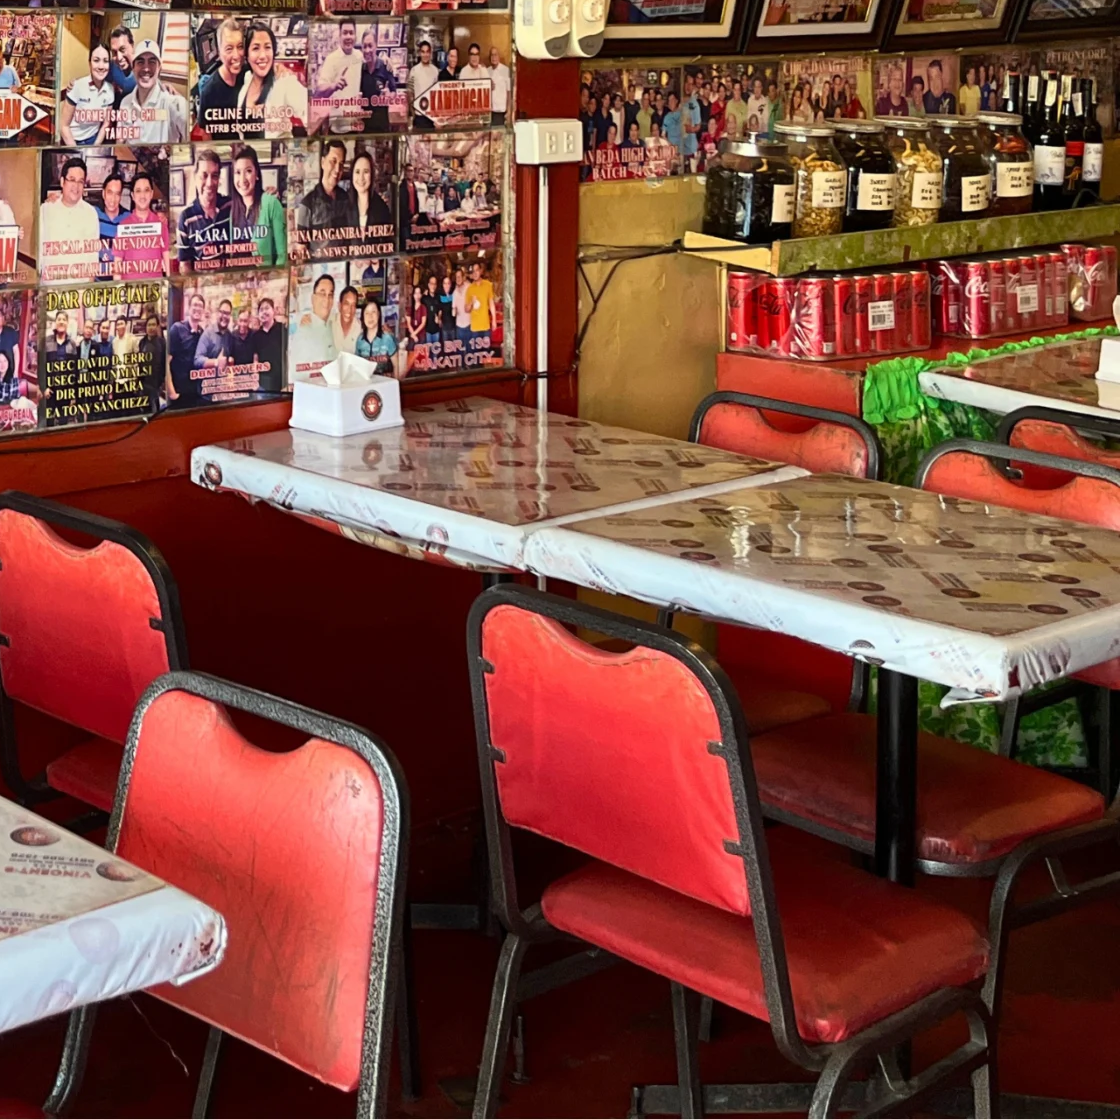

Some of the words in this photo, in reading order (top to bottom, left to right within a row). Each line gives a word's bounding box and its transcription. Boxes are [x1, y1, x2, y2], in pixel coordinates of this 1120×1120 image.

[194, 227, 229, 242] KARA
[232, 224, 268, 239] DAVID
[46, 290, 81, 311] DAR
[83, 284, 161, 307] OFFICIALS
[56, 388, 82, 401] DIR
[84, 384, 113, 398] PRIMO
[115, 381, 144, 394] LARA
